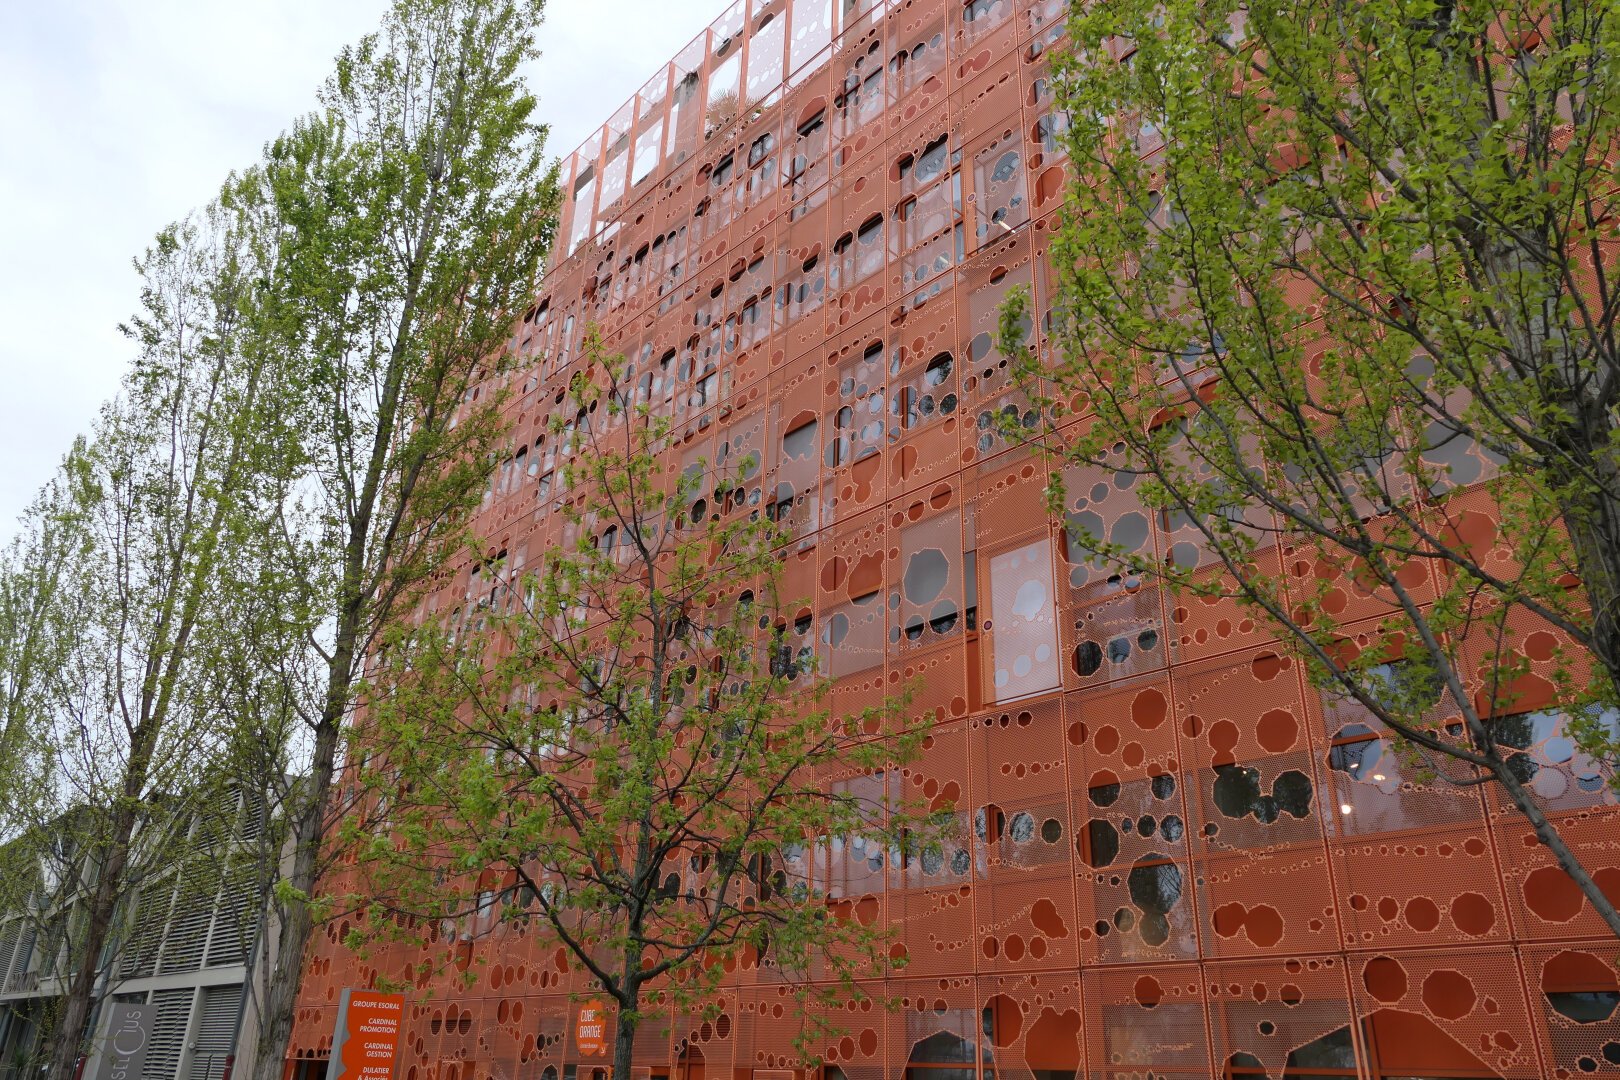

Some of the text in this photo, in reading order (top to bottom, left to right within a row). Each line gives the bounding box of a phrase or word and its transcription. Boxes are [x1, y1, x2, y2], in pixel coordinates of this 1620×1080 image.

[352, 1000, 400, 1010] GROUPE ESORAL
[580, 1009, 596, 1022] CUBE
[368, 1017, 397, 1026] CARDINAL
[359, 1025, 397, 1034] PROMOTION
[579, 1025, 601, 1038] ORANGE
[364, 1042, 393, 1050] CARDINAL
[366, 1050, 392, 1058] GESTION
[362, 1066, 390, 1074] DULATIER
